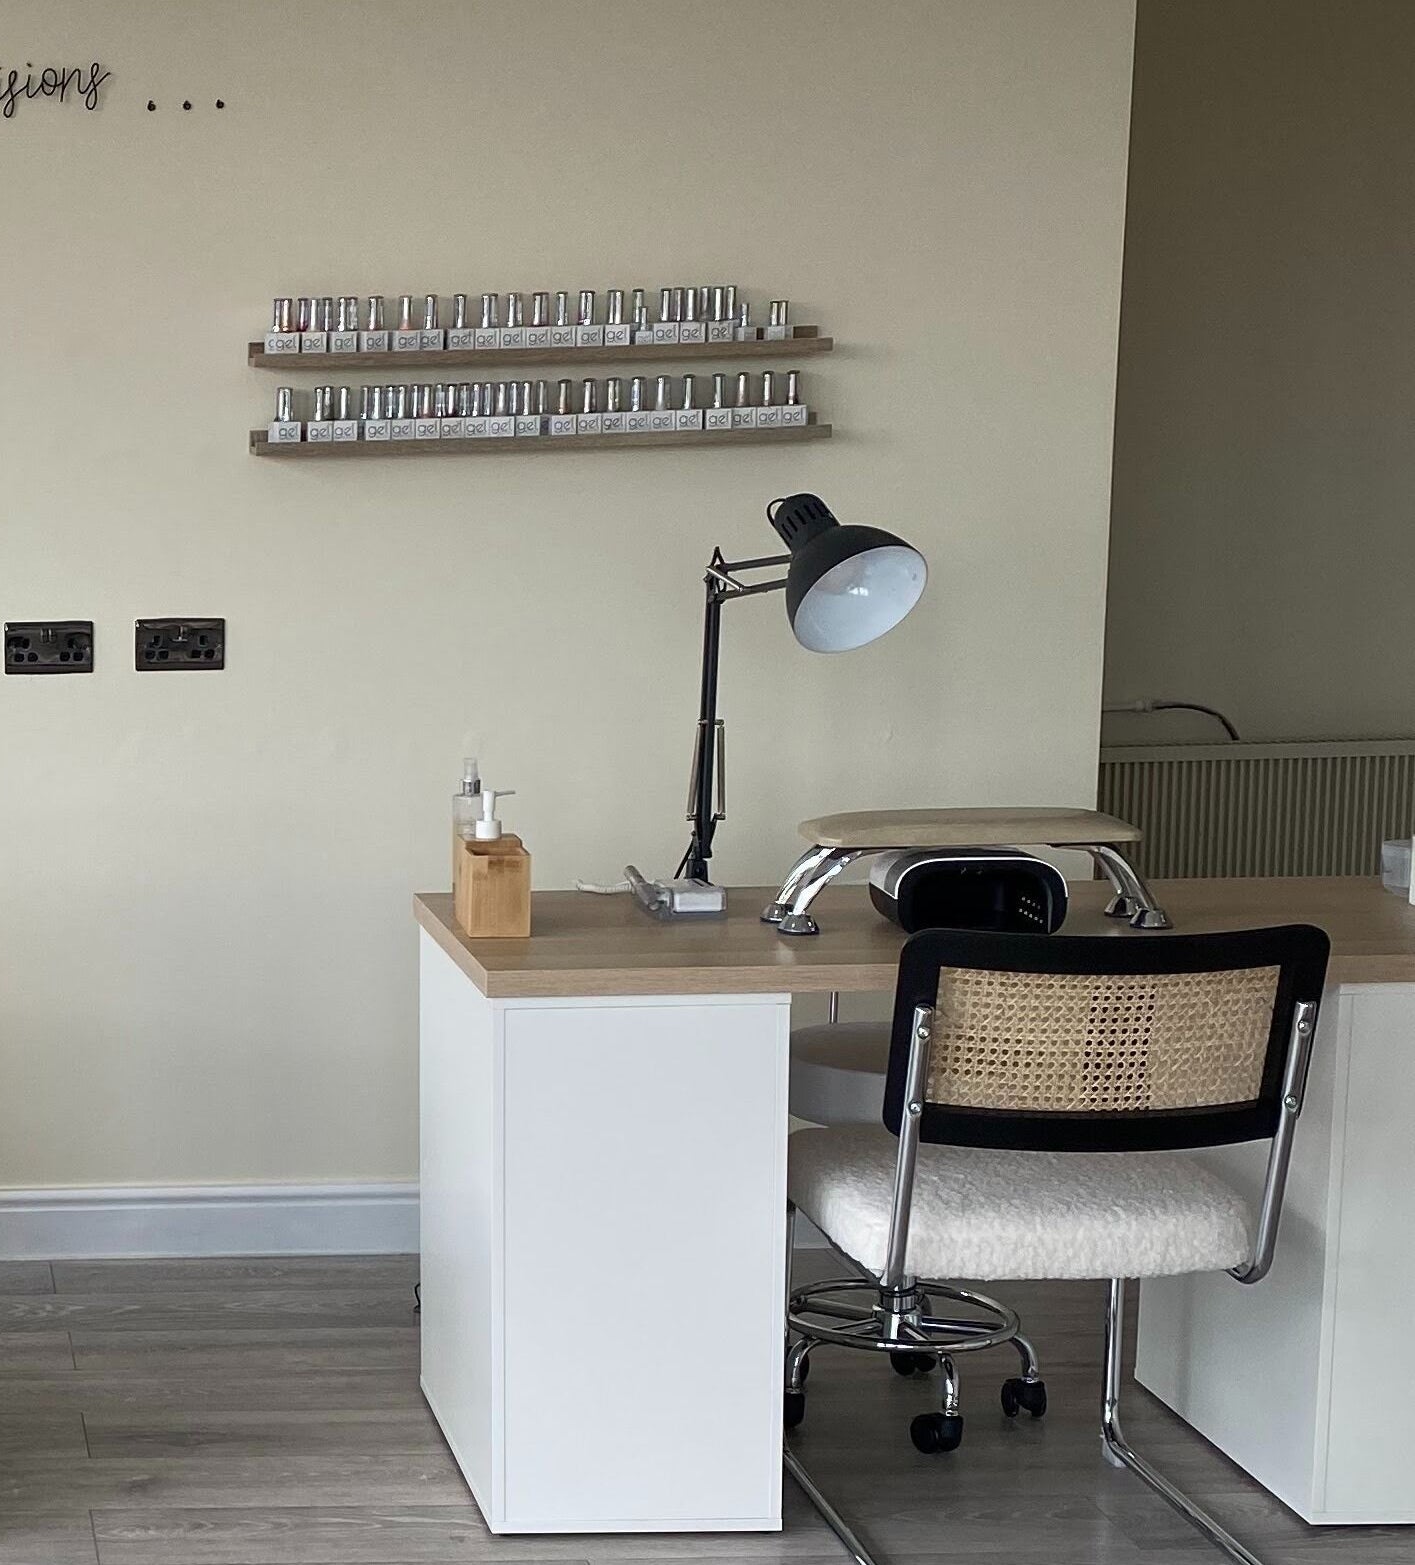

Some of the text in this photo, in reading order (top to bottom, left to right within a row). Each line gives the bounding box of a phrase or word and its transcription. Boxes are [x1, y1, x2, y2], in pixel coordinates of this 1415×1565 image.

[477, 330, 497, 347] gel
[503, 329, 524, 346] gel
[528, 329, 550, 346] gel
[552, 328, 573, 345] gel
[581, 328, 602, 344] gel
[606, 326, 627, 342] gel
[656, 323, 678, 341] gel
[682, 323, 702, 341] gel
[711, 322, 732, 339] gel
[275, 333, 296, 351] gel
[303, 334, 324, 351] gel
[335, 334, 355, 350] gel
[366, 333, 385, 350] gel
[398, 333, 418, 350] gel
[420, 332, 441, 350] gel
[451, 331, 472, 348] gel
[579, 415, 599, 431] gel
[603, 414, 624, 430] gel
[628, 413, 648, 430] gel
[652, 412, 673, 428] gel
[679, 411, 699, 428] gel
[708, 411, 728, 427] gel
[734, 411, 753, 426] gel
[759, 409, 778, 423] gel
[783, 407, 803, 423] gel
[278, 424, 299, 440] gel
[309, 424, 330, 440] gel
[334, 424, 355, 440] gel
[368, 422, 389, 438] gel
[392, 422, 413, 437] gel
[417, 420, 438, 437] gel
[442, 421, 463, 436] gel
[466, 419, 487, 435] gel
[491, 418, 512, 434] gel
[517, 417, 538, 433] gel
[554, 416, 574, 432] gel
